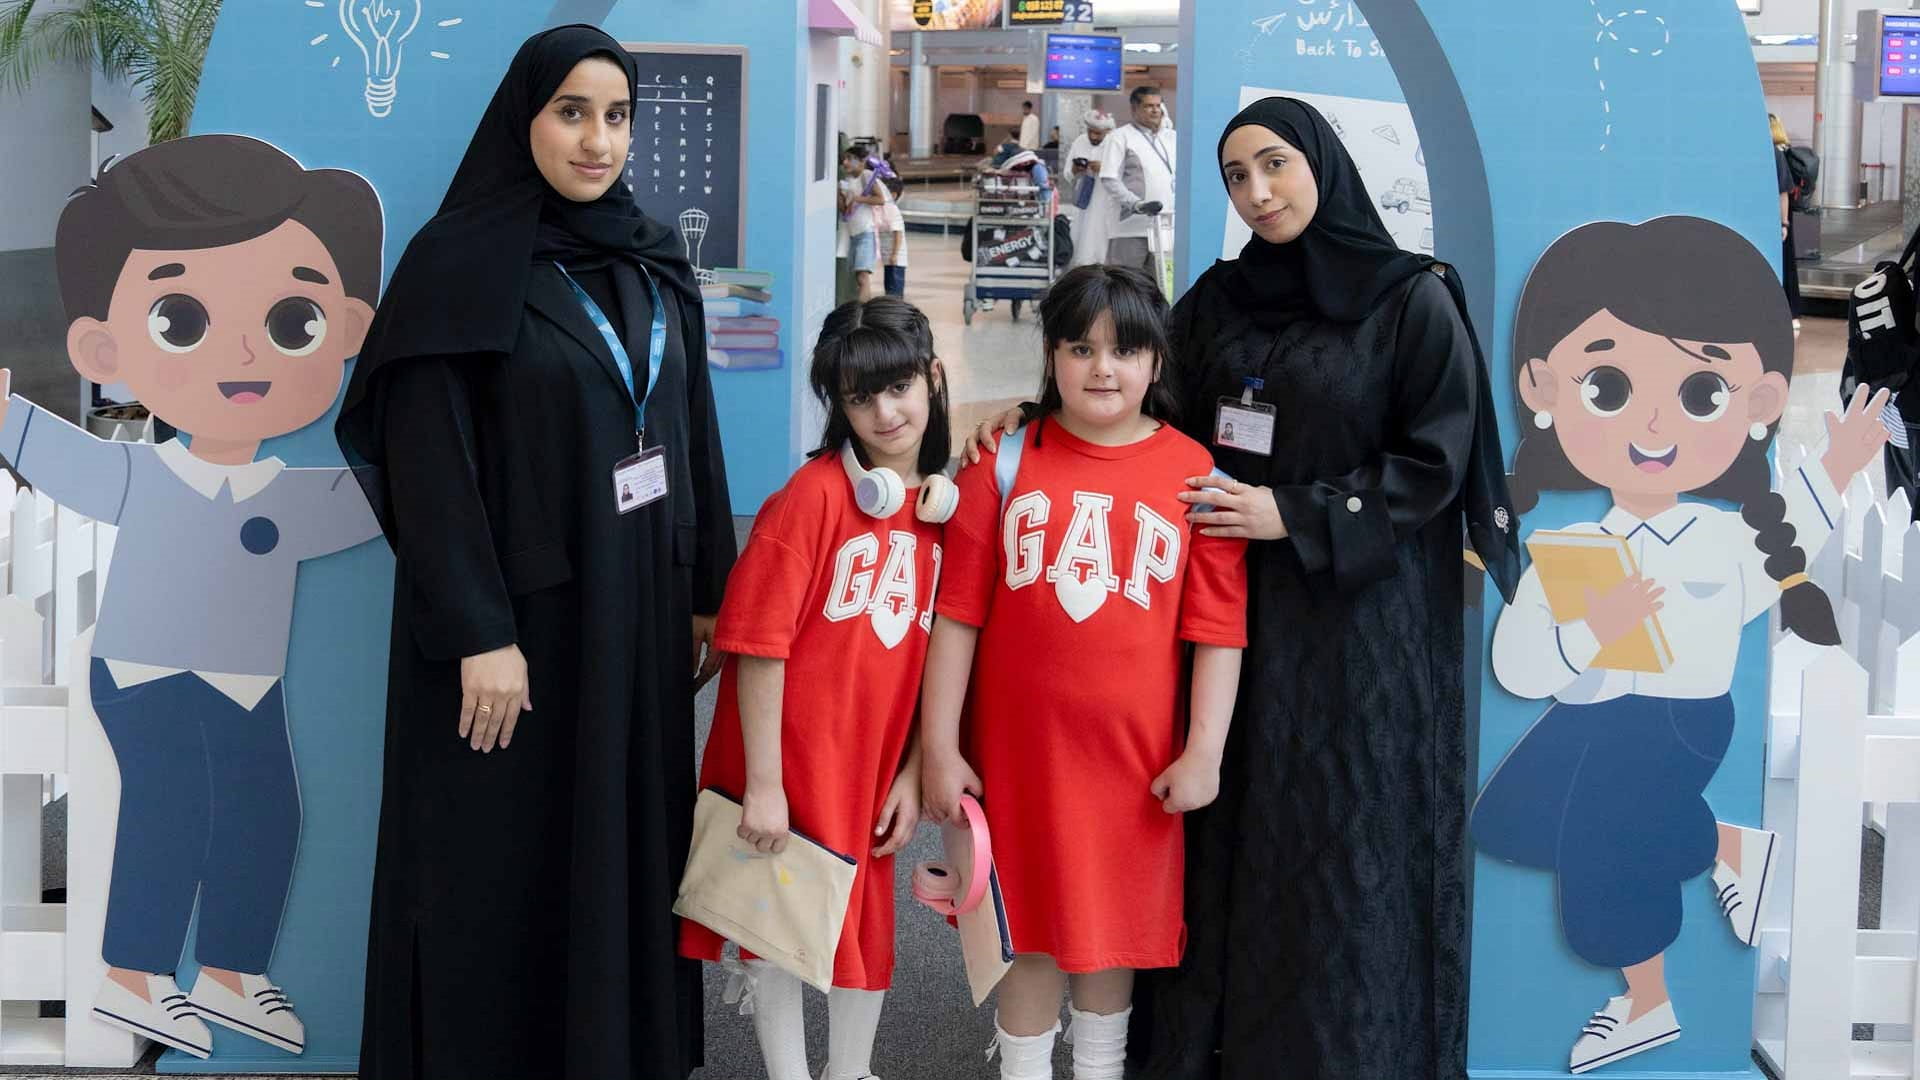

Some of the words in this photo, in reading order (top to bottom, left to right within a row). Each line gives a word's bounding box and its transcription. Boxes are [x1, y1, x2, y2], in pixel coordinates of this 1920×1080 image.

[1296, 37, 1335, 56] Back
[1342, 39, 1362, 58] To
[988, 234, 1033, 258] ENERGY
[1003, 490, 1182, 610] GAP
